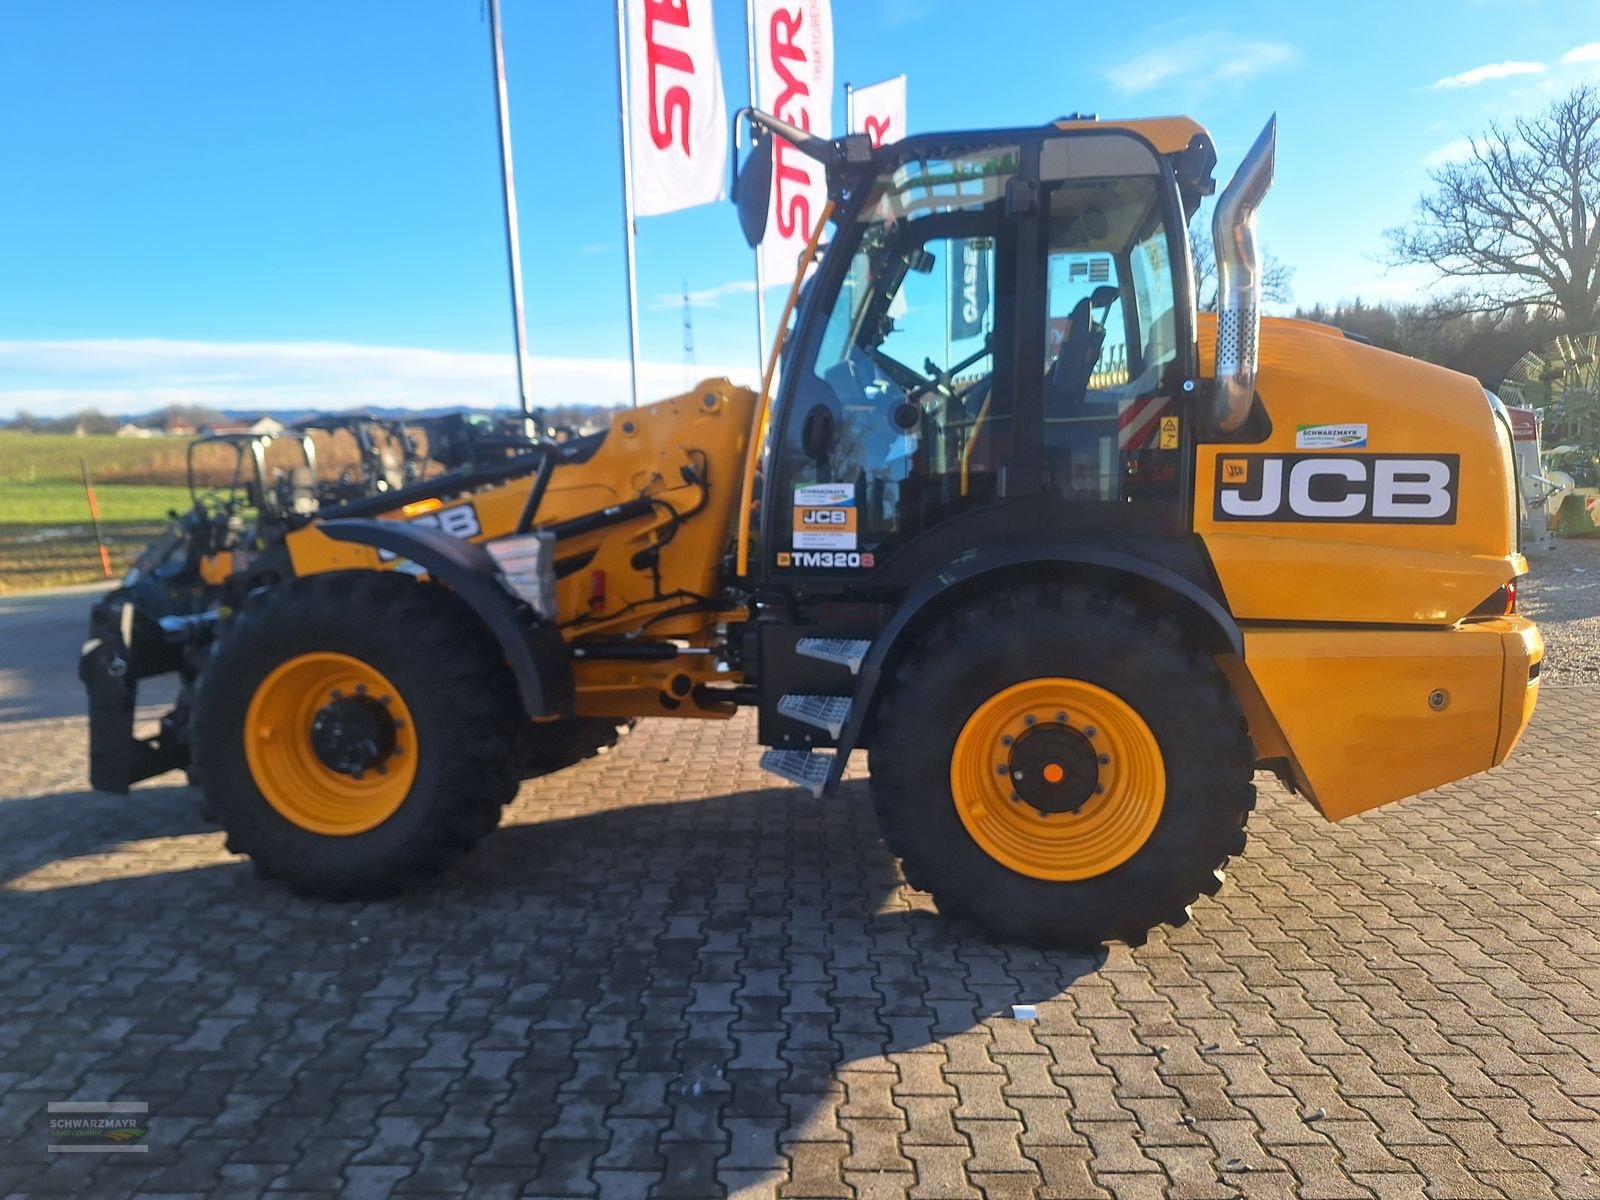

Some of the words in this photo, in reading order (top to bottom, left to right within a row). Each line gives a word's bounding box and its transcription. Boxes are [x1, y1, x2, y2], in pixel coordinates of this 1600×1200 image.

[963, 243, 979, 324] CASE
[804, 511, 845, 524] JCB
[1221, 458, 1450, 518] JCB
